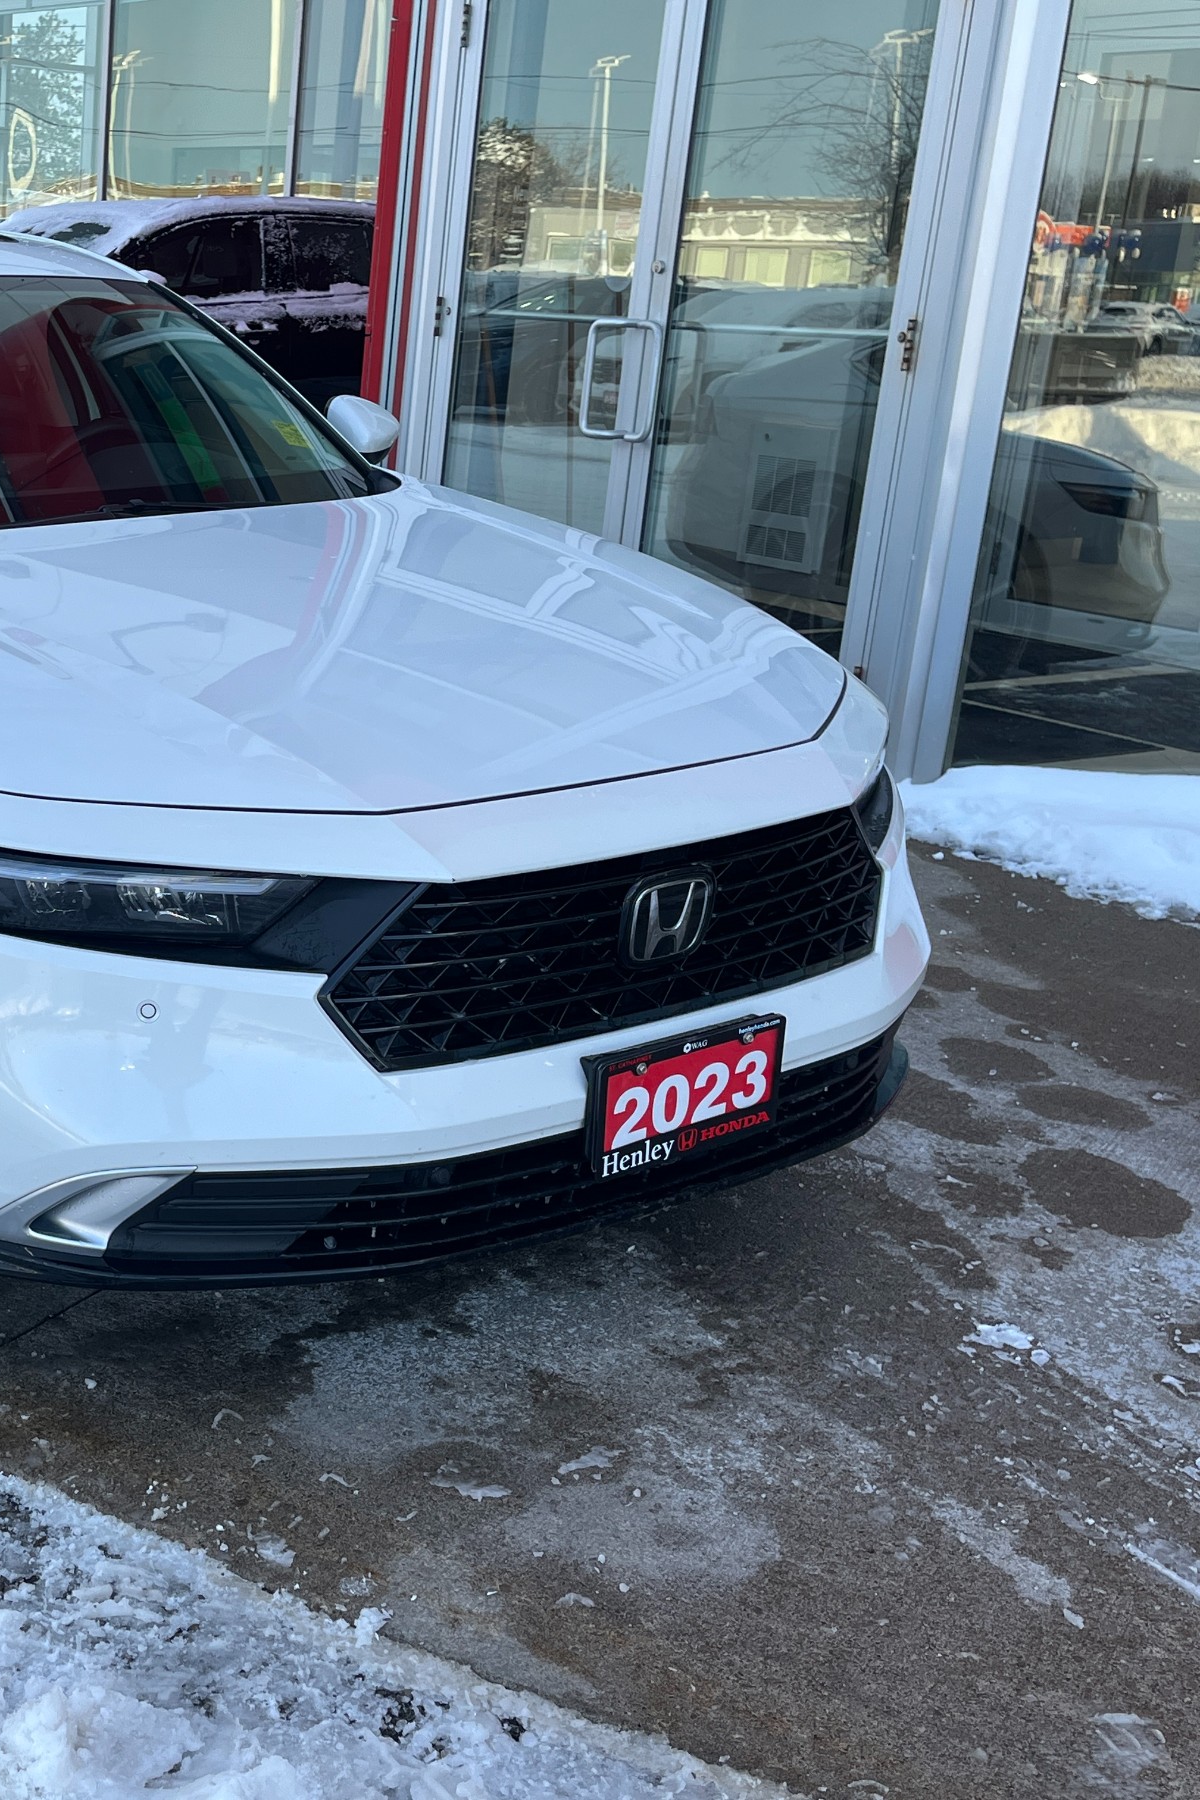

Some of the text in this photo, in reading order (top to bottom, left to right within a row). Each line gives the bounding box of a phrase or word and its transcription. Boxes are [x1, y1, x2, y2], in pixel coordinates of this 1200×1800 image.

[612, 1050, 768, 1150] 2023
[601, 1139, 675, 1178] Henley
[700, 1111, 770, 1142] HONDA
